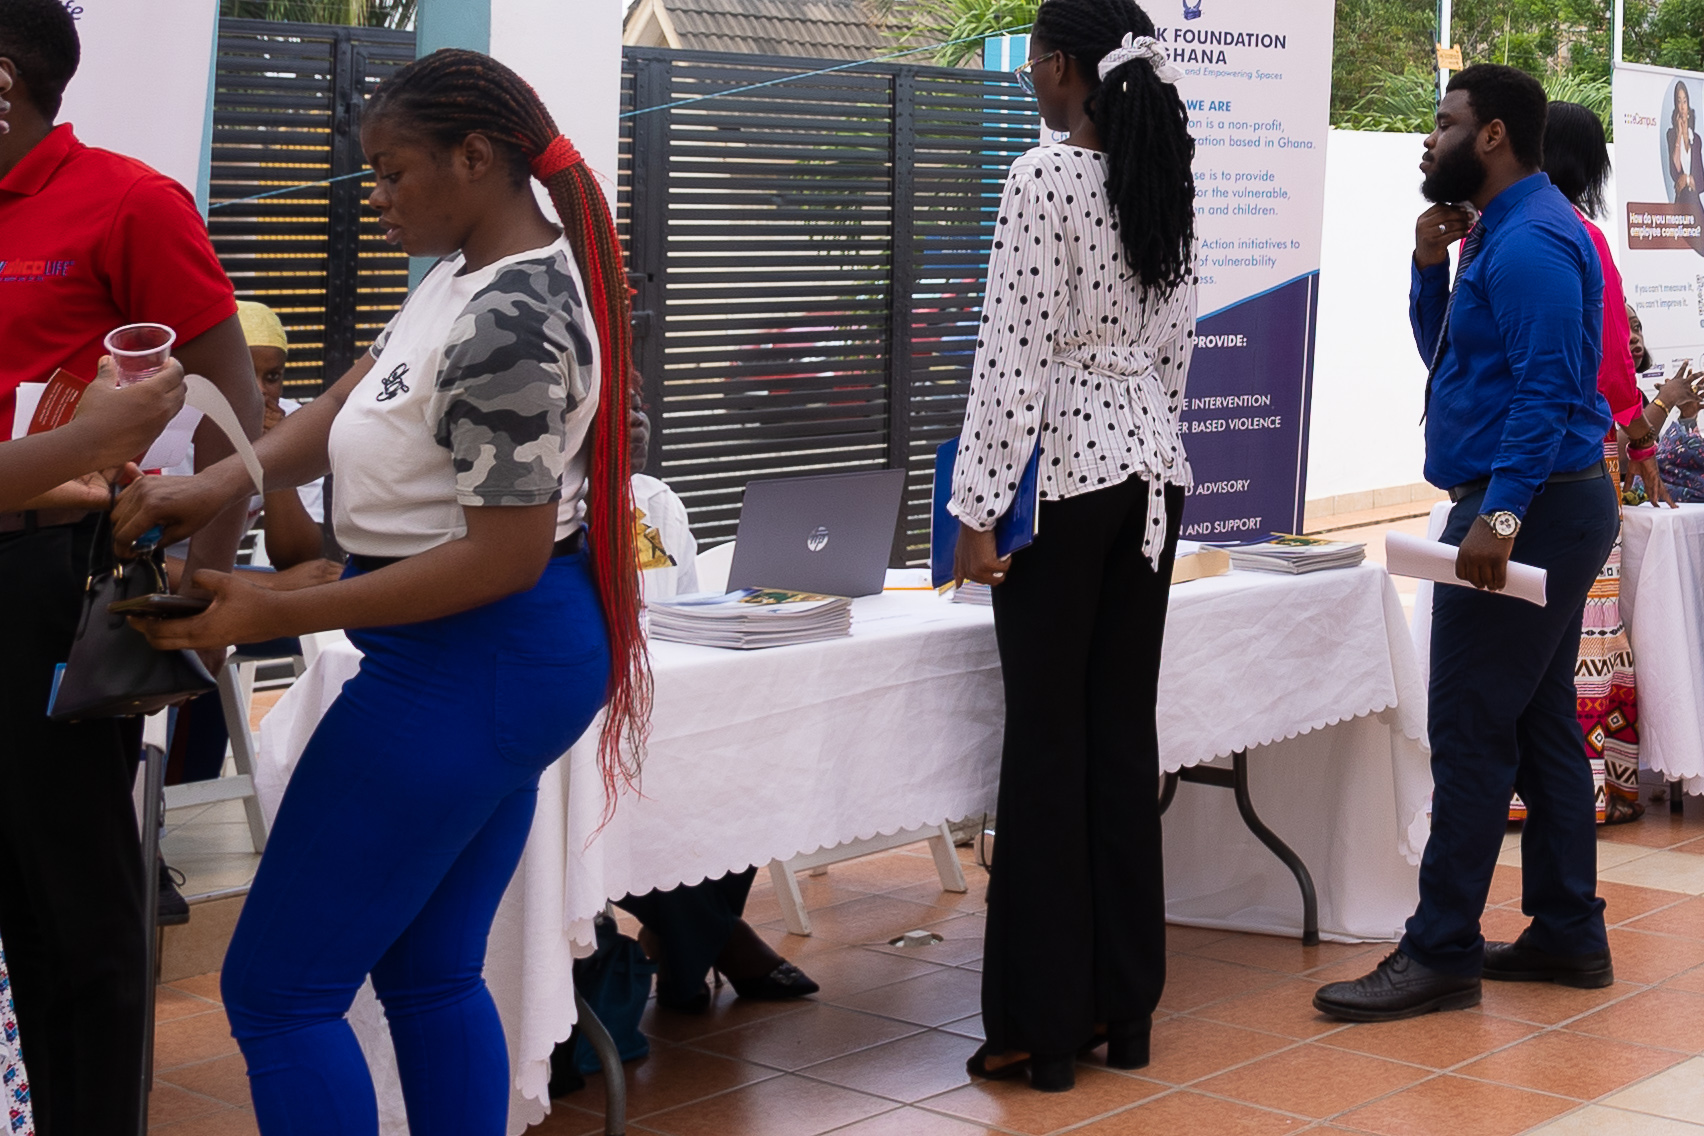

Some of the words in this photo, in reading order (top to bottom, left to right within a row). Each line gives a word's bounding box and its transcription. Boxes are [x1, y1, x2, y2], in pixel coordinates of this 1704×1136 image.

[1174, 28, 1287, 49] FOUNDATION
[1185, 67, 1201, 75] and
[1203, 67, 1252, 80] Empowering
[1255, 69, 1283, 80] Spaces
[1186, 99, 1205, 111] WE
[1208, 100, 1231, 112] ARE
[1206, 117, 1214, 129] is
[1218, 121, 1225, 129] a
[1228, 119, 1285, 133] non-profit,
[1229, 135, 1260, 147] based
[1264, 136, 1274, 147] in
[1278, 137, 1316, 149] Ghana.
[1209, 169, 1217, 180] is
[1222, 171, 1231, 180] to
[1235, 170, 1275, 183] provide
[1212, 186, 1229, 198] the
[1232, 187, 1291, 200] vulnerable,
[1208, 203, 1229, 215] and
[1232, 204, 1278, 216] children.
[1643, 212, 1651, 224] do
[1652, 214, 1665, 227] you
[1666, 215, 1694, 225] measure
[1630, 226, 1661, 240] employee
[1662, 225, 1701, 240] compliance?
[1201, 238, 1234, 249] Action
[1238, 238, 1287, 250] initiatives
[1290, 239, 1300, 250] to
[1212, 254, 1277, 269] vulnerability
[1192, 394, 1271, 411] INTERVENTION
[1192, 420, 1226, 433] BASED
[1229, 416, 1281, 431] VIOLENCE
[1196, 479, 1250, 495] ADVISORY
[1186, 522, 1211, 536] AND
[1214, 517, 1262, 533] SUPPORT
